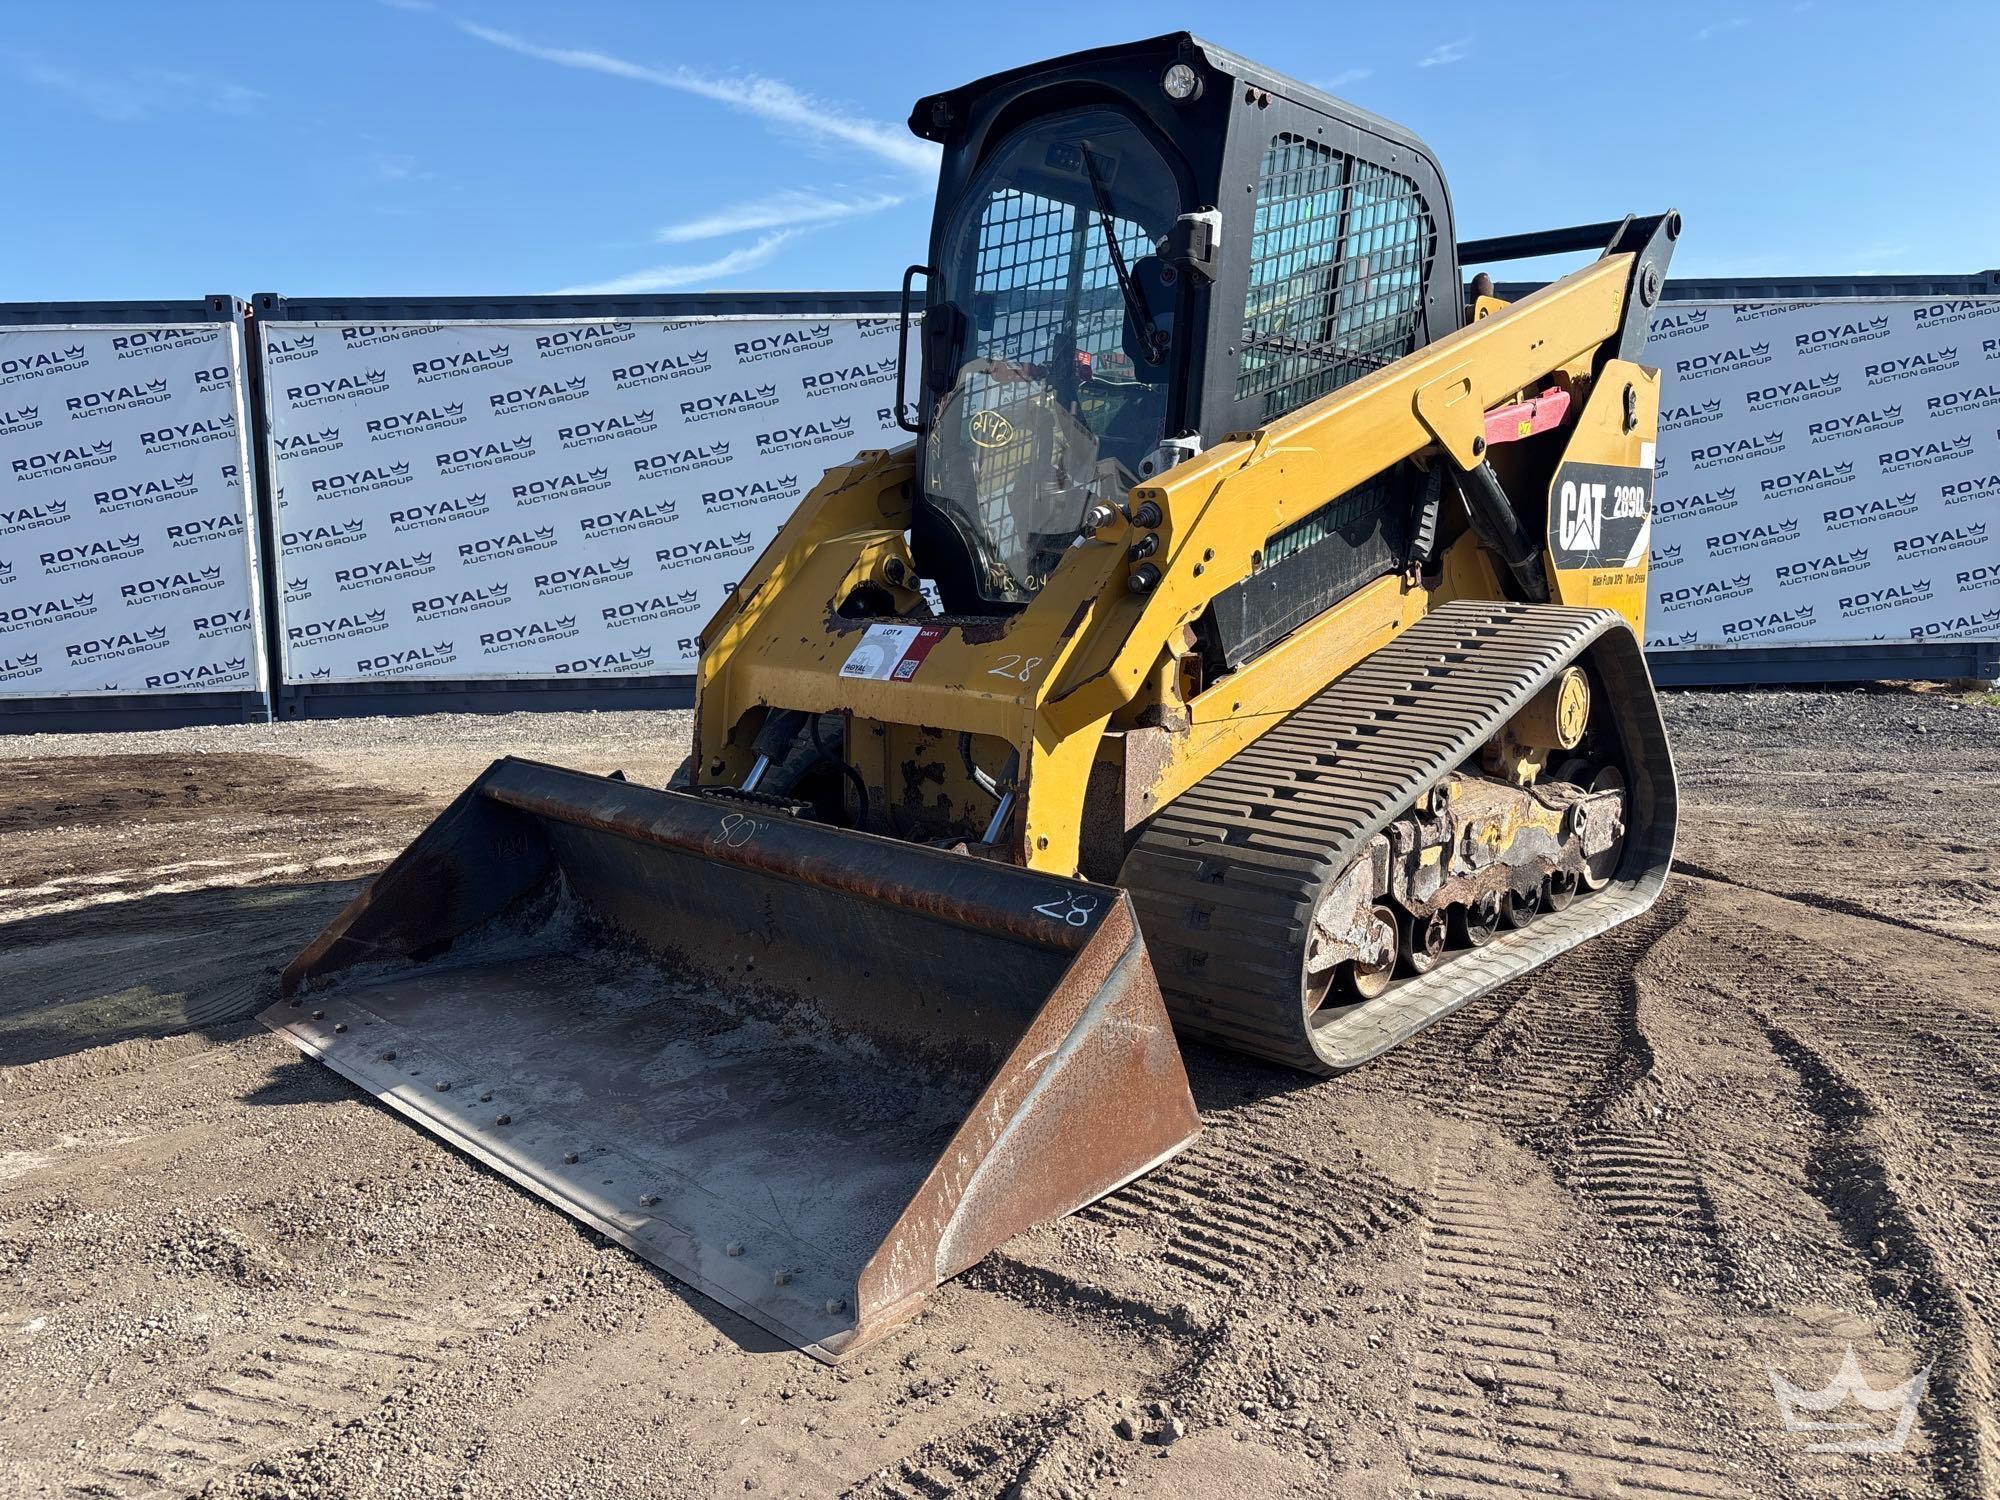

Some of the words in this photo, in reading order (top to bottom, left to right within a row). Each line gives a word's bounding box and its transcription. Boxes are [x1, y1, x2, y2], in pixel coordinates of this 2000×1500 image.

[535, 324, 613, 350] ROYAL
[540, 342, 593, 359] AUCTION
[594, 332, 636, 347] GROUP
[734, 330, 811, 356] ROYAL
[1795, 322, 1870, 347] ROYAL
[1798, 339, 1849, 356] AUCTION
[1850, 330, 1891, 344] GROUP
[412, 350, 491, 375] ROYAL
[739, 348, 791, 365] AUCTION
[792, 338, 834, 353] GROUP
[1676, 348, 1751, 373] ROYAL
[417, 367, 470, 384] AUCTION
[471, 358, 513, 373] GROUP
[612, 356, 689, 382] ROYAL
[617, 373, 669, 390] AUCTION
[670, 364, 712, 379] GROUP
[802, 364, 878, 389] ROYAL
[1679, 365, 1730, 382] AUCTION
[1731, 356, 1772, 370] GROUP
[1865, 353, 1939, 378] ROYAL
[1868, 370, 1918, 386] AUCTION
[1919, 361, 1960, 375] GROUP
[65, 385, 148, 411] ROYAL
[287, 376, 367, 401] ROYAL
[292, 393, 345, 409] AUCTION
[347, 384, 390, 398] GROUP
[489, 382, 567, 408] ROYAL
[1746, 379, 1821, 404] ROYAL
[71, 403, 126, 420] AUCTION
[128, 393, 172, 408] GROUP
[494, 399, 546, 416] AUCTION
[548, 390, 590, 405] GROUP
[680, 390, 757, 415] ROYAL
[684, 407, 736, 424] AUCTION
[738, 398, 780, 412] GROUP
[140, 419, 221, 446] ROYAL
[366, 408, 445, 433] ROYAL
[371, 425, 424, 442] AUCTION
[425, 416, 468, 431] GROUP
[558, 415, 635, 441] ROYAL
[973, 414, 1008, 442] 2142
[1808, 411, 1883, 436] ROYAL
[1811, 428, 1862, 444] AUCTION
[1864, 418, 1904, 433] GROUP
[563, 433, 615, 450] AUCTION
[616, 423, 658, 438] GROUP
[755, 422, 832, 447] ROYAL
[760, 439, 812, 456] AUCTION
[813, 430, 854, 444] GROUP
[11, 446, 93, 473] ROYAL
[436, 441, 513, 467] ROYAL
[440, 459, 493, 476] AUCTION
[494, 449, 536, 464] GROUP
[634, 447, 711, 472] ROYAL
[1690, 437, 1765, 462] ROYAL
[1694, 454, 1744, 470] AUCTION
[1745, 445, 1786, 459] GROUP
[1878, 441, 1953, 466] ROYAL
[1882, 458, 1932, 474] AUCTION
[1934, 449, 1974, 463] GROUP
[17, 465, 72, 482] AUCTION
[73, 455, 117, 470] GROUP
[311, 467, 391, 493] ROYAL
[1760, 467, 1835, 492] ROYAL
[93, 479, 175, 505] ROYAL
[317, 485, 370, 501] AUCTION
[371, 475, 414, 490] GROUP
[512, 473, 589, 498] ROYAL
[517, 490, 569, 507] AUCTION
[570, 481, 612, 495] GROUP
[701, 481, 779, 505] ROYAL
[99, 497, 154, 515] AUCTION
[155, 487, 199, 503] GROUP
[389, 499, 467, 524] ROYAL
[706, 498, 758, 514] AUCTION
[759, 489, 801, 503] GROUP
[1613, 485, 1645, 518] 289D
[1823, 499, 1897, 524] ROYAL
[394, 516, 446, 533] AUCTION
[448, 507, 490, 521] GROUP
[580, 506, 657, 531] ROYAL
[1560, 481, 1606, 550] CAT
[1826, 515, 1877, 532] AUCTION
[1878, 506, 1919, 520] GROUP
[458, 532, 536, 557] ROYAL
[655, 537, 733, 562] ROYAL
[1706, 525, 1780, 549] ROYAL
[1709, 541, 1759, 558] AUCTION
[1760, 532, 1801, 546] GROUP
[1893, 528, 1968, 553] ROYAL
[1897, 545, 1947, 561] AUCTION
[1948, 536, 1989, 550] GROUP
[39, 540, 121, 566] ROYAL
[45, 558, 99, 575] AUCTION
[101, 548, 145, 563] GROUP
[463, 549, 515, 566] AUCTION
[516, 540, 558, 554] GROUP
[660, 554, 712, 571] AUCTION
[713, 545, 755, 560] GROUP
[335, 558, 413, 583] ROYAL
[340, 575, 392, 592] AUCTION
[394, 566, 436, 580] GROUP
[534, 563, 611, 588] ROYAL
[1775, 554, 1850, 579] ROYAL
[120, 572, 202, 598] ROYAL
[126, 589, 180, 607] AUCTION
[182, 580, 225, 595] GROUP
[538, 580, 590, 597] AUCTION
[592, 571, 633, 585] GROUP
[1659, 580, 1733, 605] ROYAL
[412, 589, 489, 614] ROYAL
[602, 596, 679, 621] ROYAL
[1663, 596, 1712, 613] AUCTION
[1714, 587, 1754, 602] GROUP
[1838, 585, 1913, 610] ROYAL
[1842, 602, 1892, 618] AUCTION
[1893, 593, 1934, 607] GROUP
[288, 615, 367, 640] ROYAL
[606, 612, 658, 629] AUCTION
[659, 603, 701, 618] GROUP
[1722, 611, 1796, 636] ROYAL
[292, 632, 346, 649] AUCTION
[347, 623, 390, 637] GROUP
[479, 621, 557, 646] ROYAL
[484, 638, 536, 655] AUCTION
[537, 629, 579, 643] GROUP
[1726, 627, 1776, 644] AUCTION
[1777, 618, 1817, 632] GROUP
[66, 632, 147, 658] ROYAL
[71, 649, 125, 667] AUCTION
[127, 640, 170, 655] GROUP
[357, 647, 435, 673] ROYAL
[555, 652, 632, 673] ROYAL
[844, 663, 866, 672] ROYAL
[988, 655, 1043, 682] 28
[146, 663, 227, 689] ROYAL
[1032, 886, 1098, 926] 28
